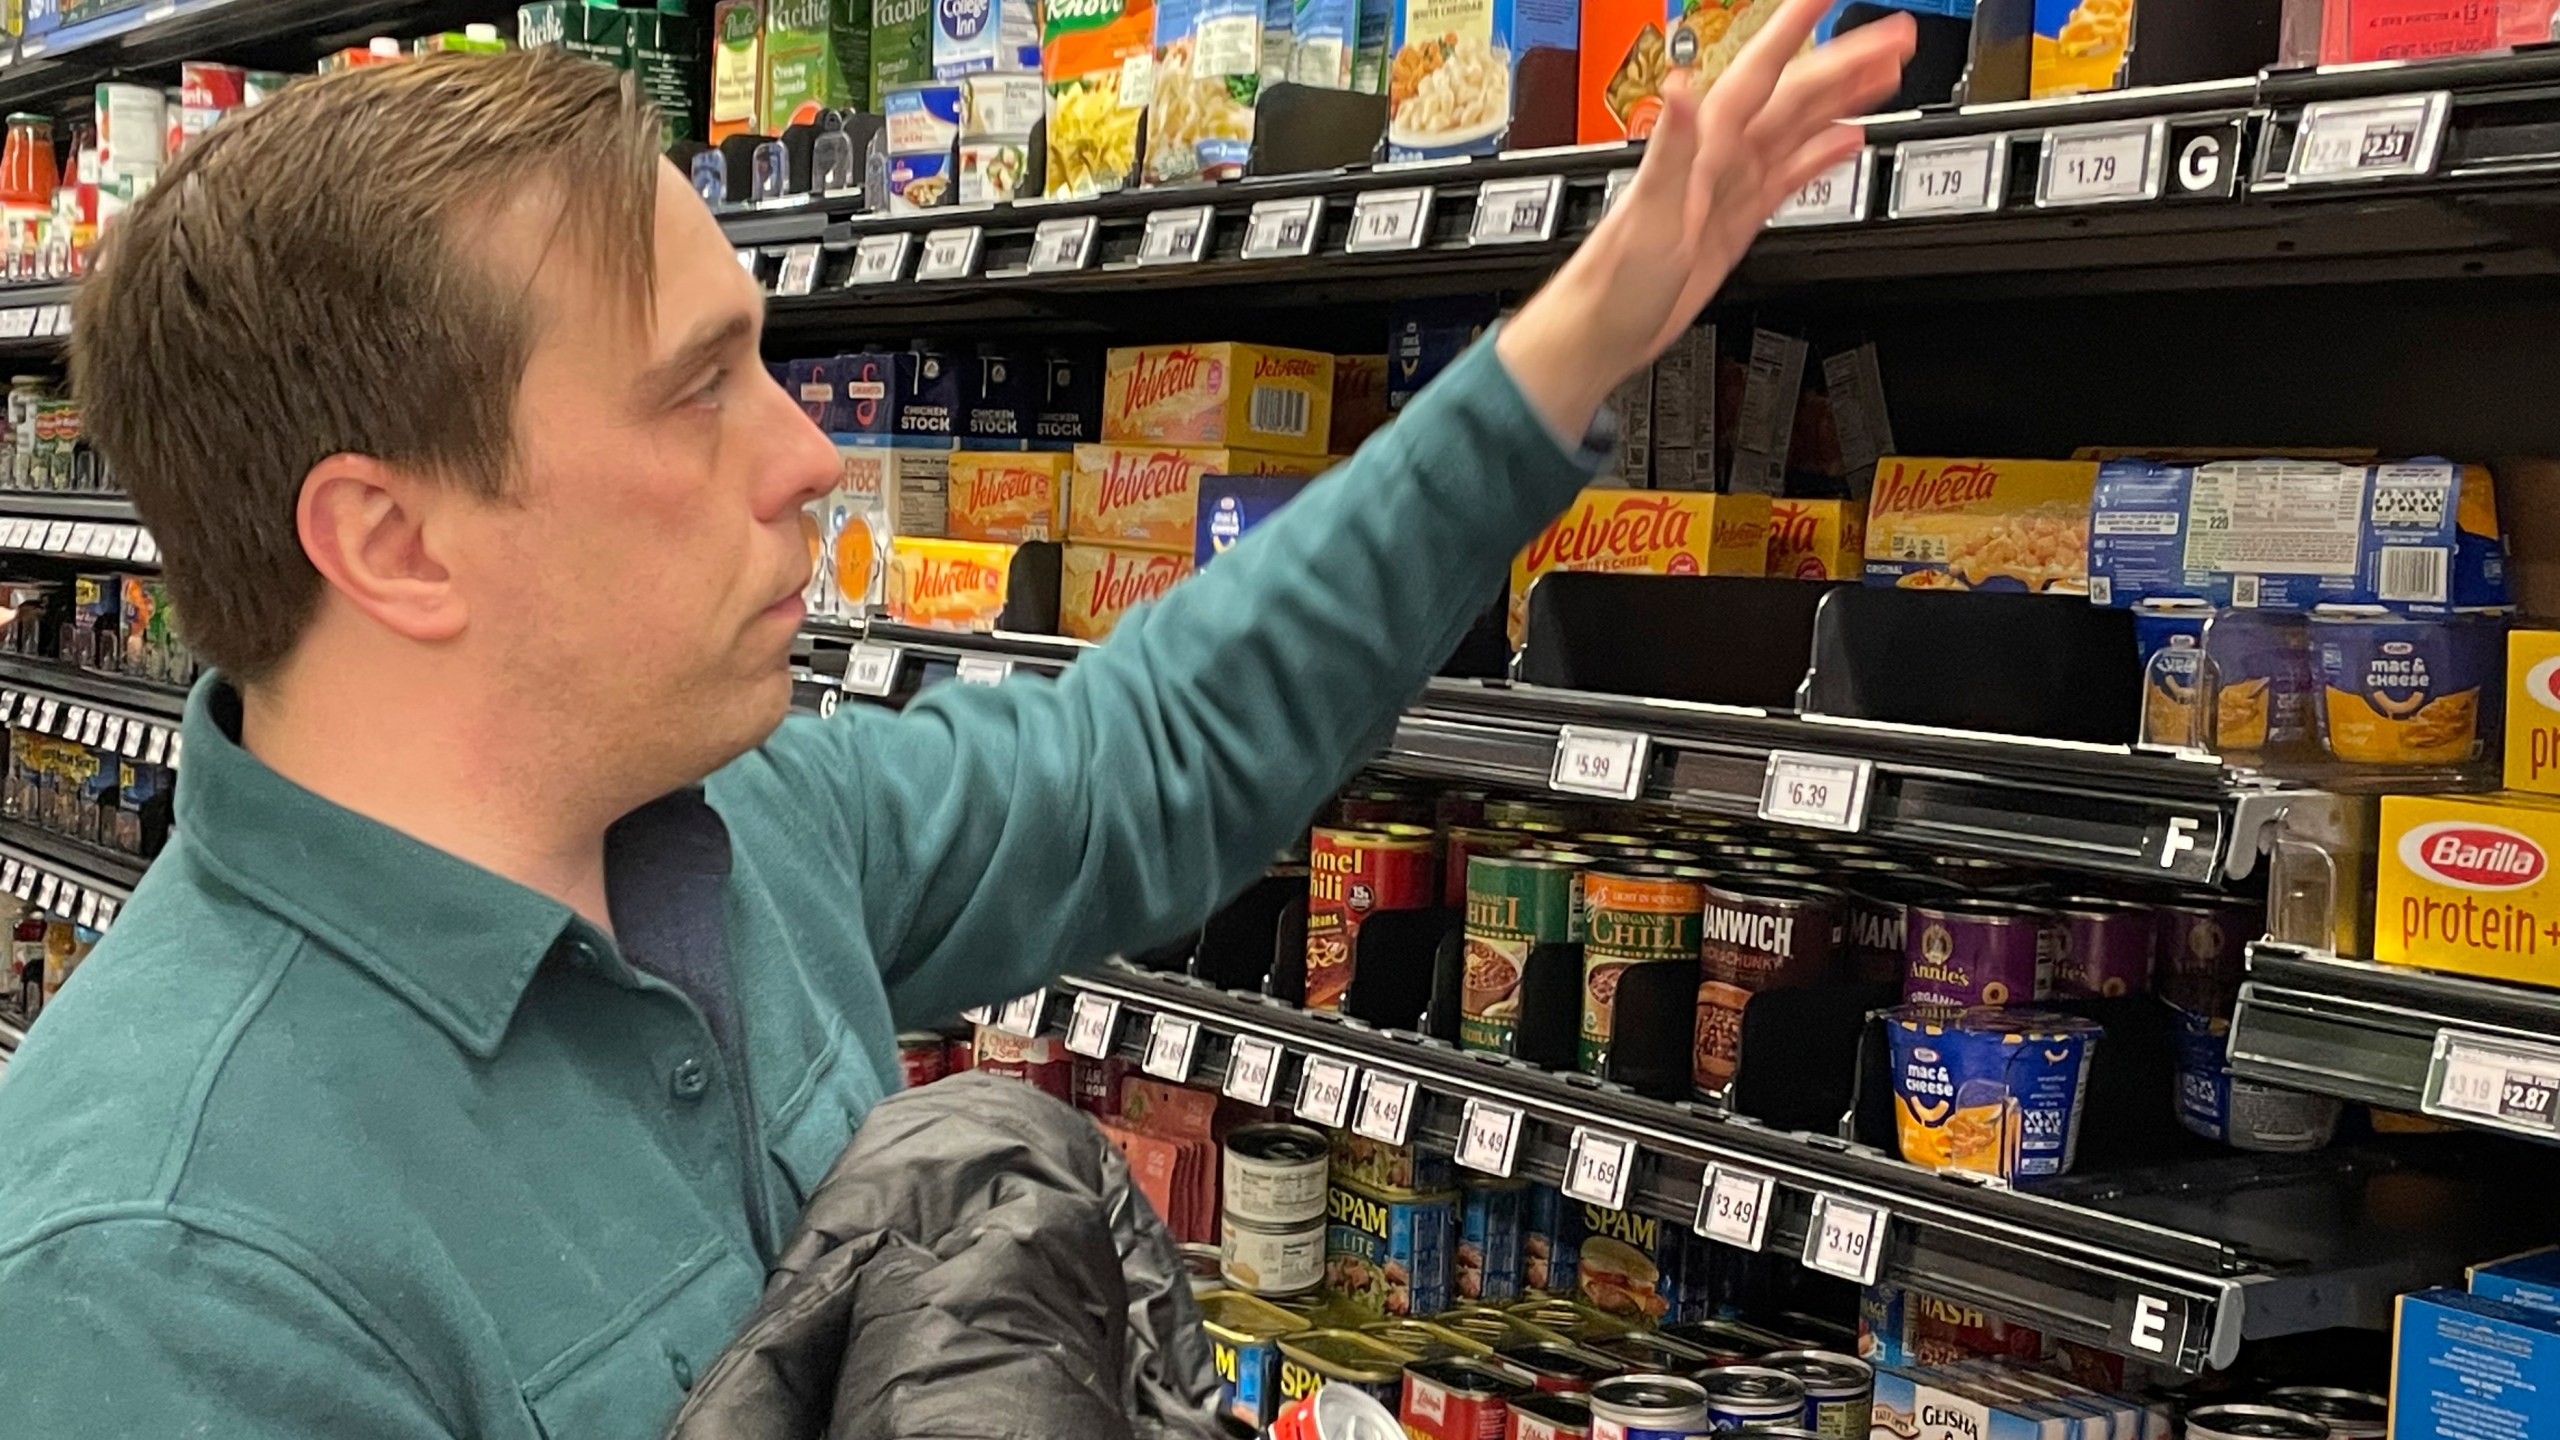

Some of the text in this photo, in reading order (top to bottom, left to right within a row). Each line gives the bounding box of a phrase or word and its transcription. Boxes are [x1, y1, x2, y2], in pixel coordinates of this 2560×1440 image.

[956, 18, 977, 36] Inn
[2069, 155, 2116, 186] $1.79
[2178, 136, 2219, 190] G
[1919, 170, 1962, 197] $1.79
[1124, 347, 1200, 420] Velveeta
[901, 416, 951, 432] STOCK
[903, 405, 948, 417] CHICKEN
[970, 419, 1018, 435] STOCK
[1037, 422, 1083, 437] STOCK
[841, 470, 882, 494] STOCK
[969, 466, 1034, 515] Velveeta
[1099, 449, 1190, 517] Velveeta
[1871, 462, 1998, 520] Velveeta
[1527, 496, 1692, 572] Velveeta
[2210, 516, 2229, 529] 220
[914, 558, 980, 604] Velveeta
[1090, 551, 1188, 618] Velveet
[1577, 754, 1610, 779] $5.99
[1788, 780, 1828, 808] $6.39
[2161, 817, 2199, 868] F
[2431, 836, 2535, 876] Barilla
[1467, 896, 1519, 930] HILI
[2403, 896, 2536, 955] protein
[1591, 910, 1687, 949] CHILI
[1910, 961, 1970, 988] Annie's
[1312, 1080, 1340, 1099] $2.69
[2503, 1083, 2551, 1112] $2.87
[1369, 1095, 1398, 1123] $4.49
[1473, 1125, 1503, 1153] $4.49
[1582, 1155, 1615, 1184] $1.69
[1328, 1186, 1388, 1240] SPAM
[1717, 1193, 1752, 1224] $3.49
[1584, 1203, 1656, 1251] SPAM
[1825, 1225, 1865, 1257] $3.19
[1343, 1233, 1375, 1258] LITE
[1920, 1294, 1983, 1328] HASH
[2130, 1294, 2168, 1353] E
[1280, 1361, 1323, 1399] SPA
[1922, 1405, 1979, 1440] GEISHA
